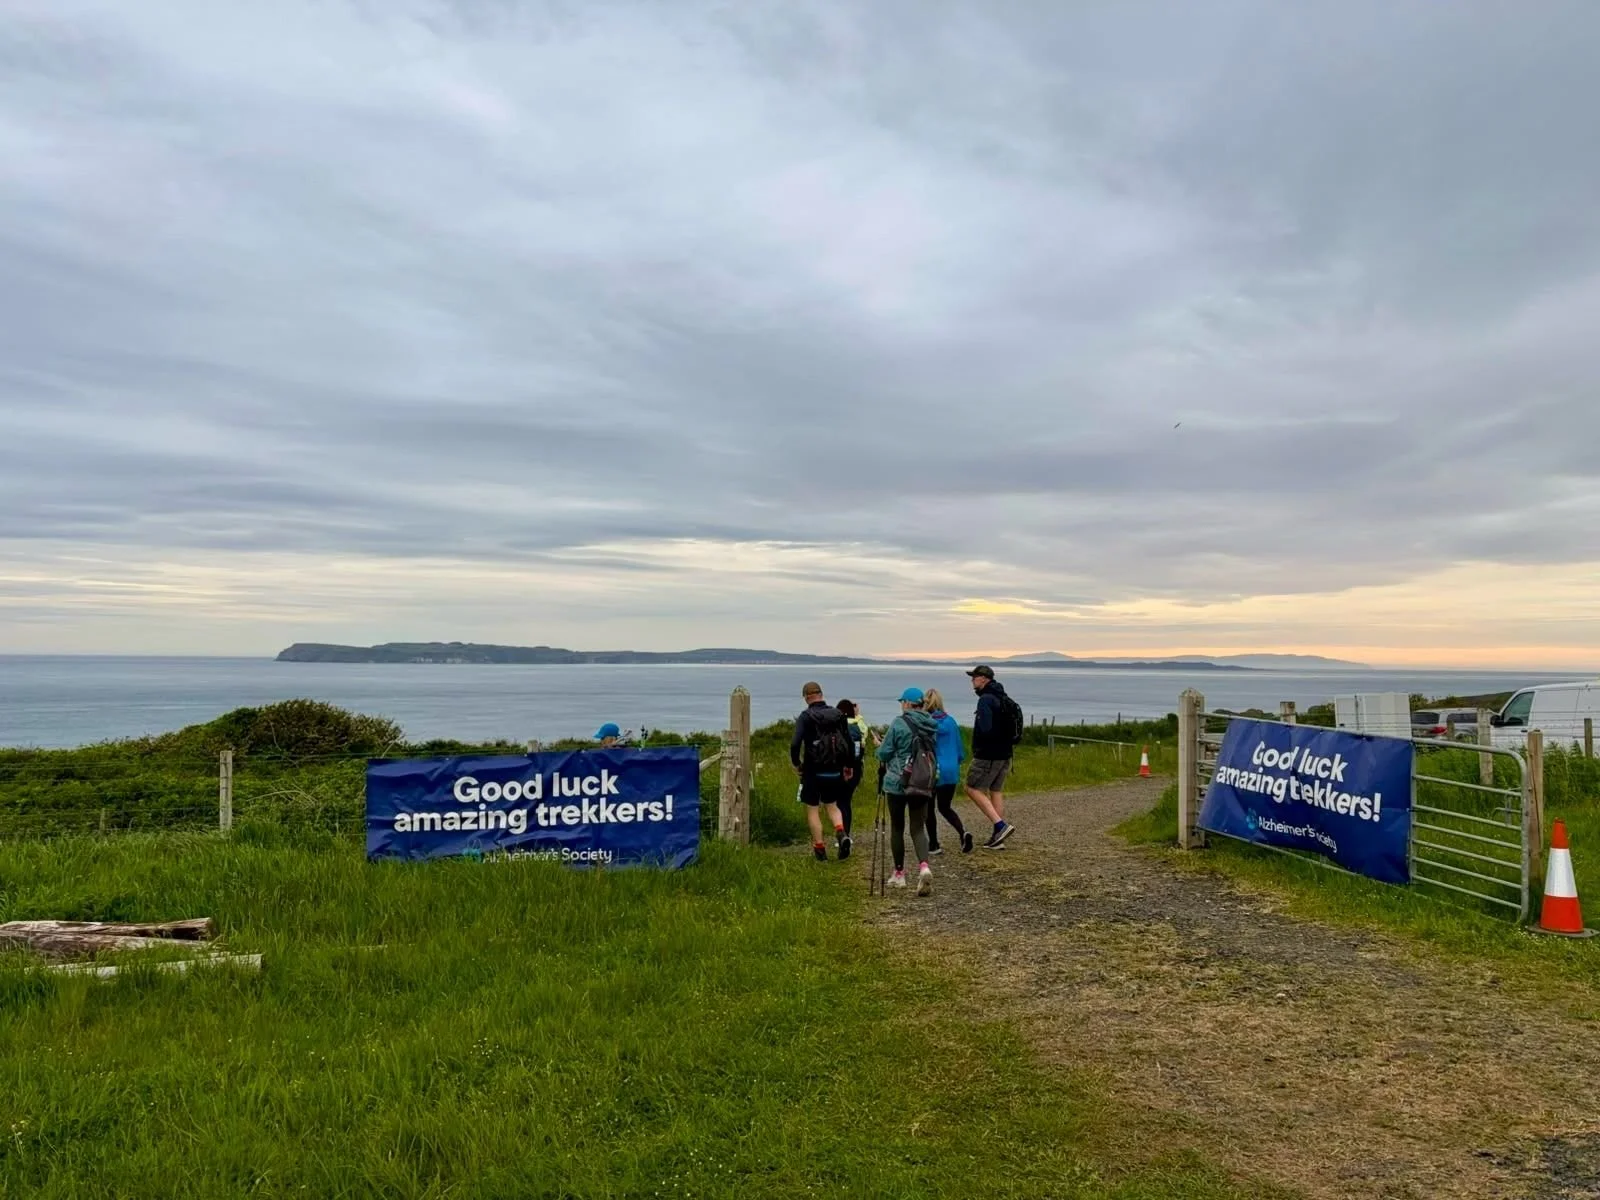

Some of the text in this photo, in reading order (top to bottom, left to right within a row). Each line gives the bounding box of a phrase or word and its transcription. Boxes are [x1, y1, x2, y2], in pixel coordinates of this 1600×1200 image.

[1297, 748, 1348, 782] luck
[453, 769, 619, 803] Good luck
[1216, 766, 1288, 803] amazing
[393, 795, 673, 834] amazing trekkers!
[1258, 815, 1315, 838] Alzheimer's
[561, 847, 612, 863] Society
